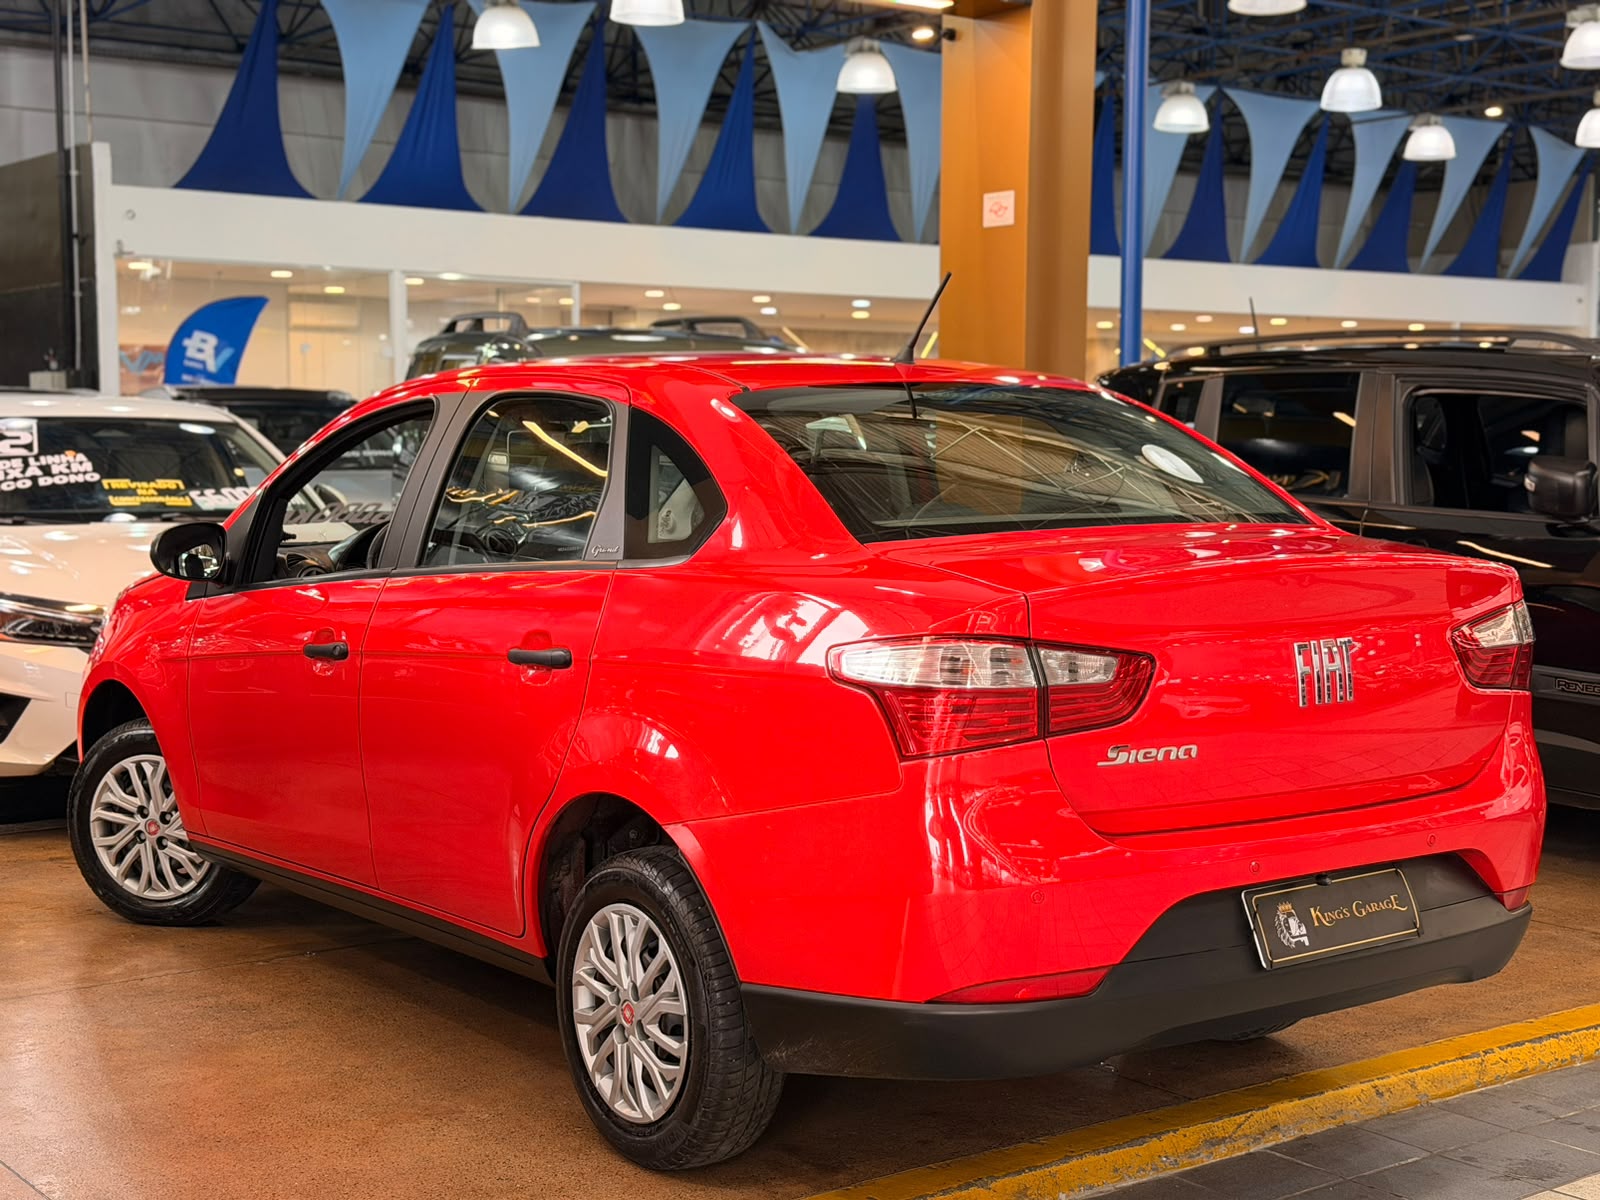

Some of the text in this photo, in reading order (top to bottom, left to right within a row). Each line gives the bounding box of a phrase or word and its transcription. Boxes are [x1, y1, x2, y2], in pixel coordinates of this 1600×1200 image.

[28, 452, 88, 466] LINHA
[51, 461, 93, 475] KM
[38, 472, 101, 487] DONO
[591, 544, 620, 558] Grand
[1293, 637, 1354, 707] FIAT
[1097, 744, 1198, 766] Siena
[1309, 894, 1409, 927] KING'S GARAGE
